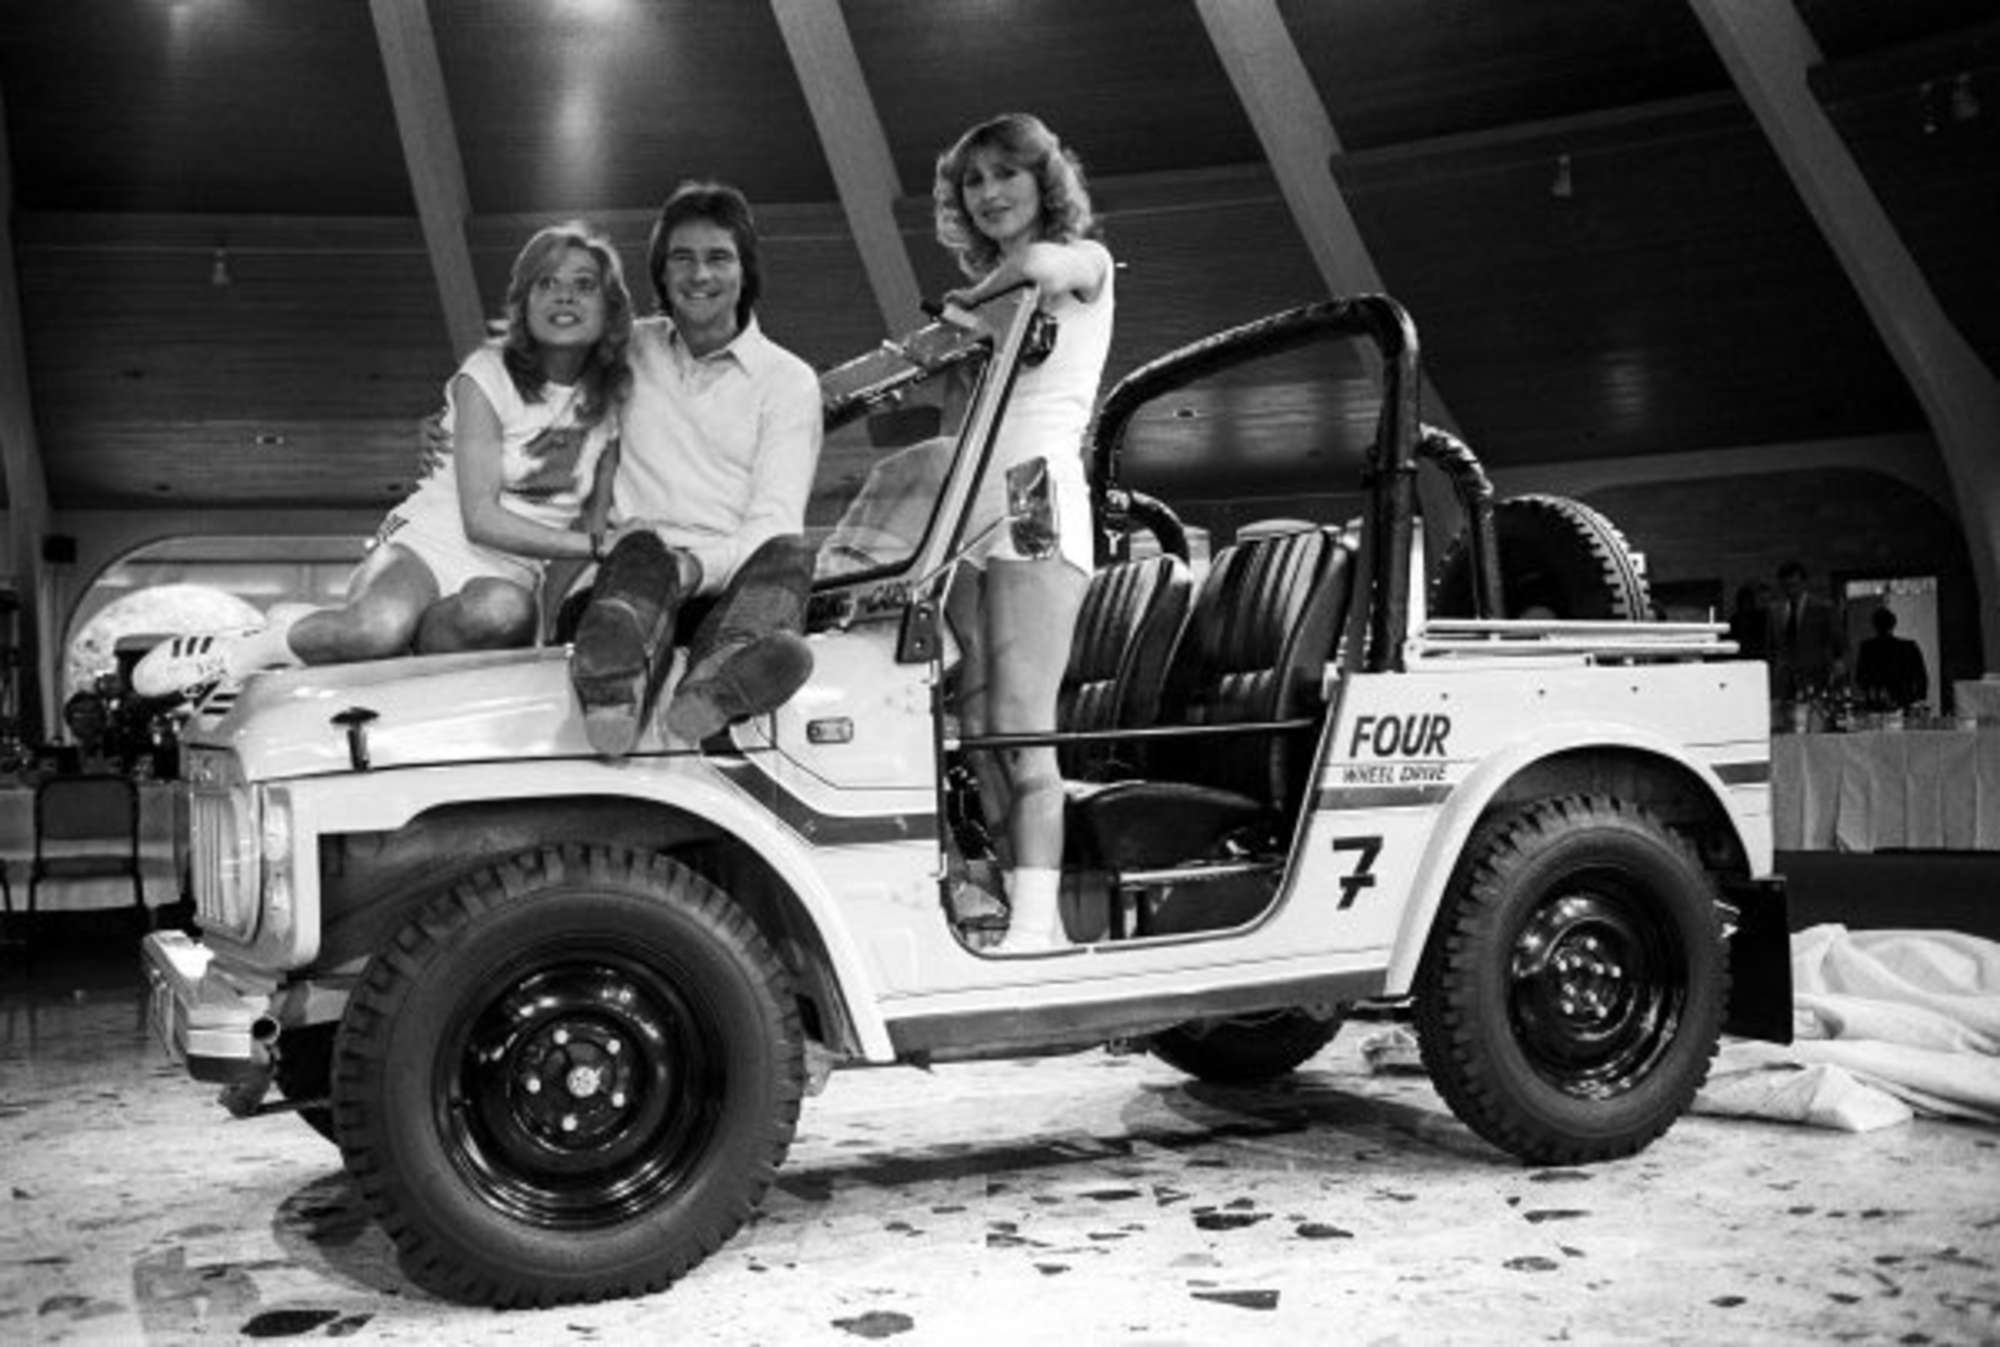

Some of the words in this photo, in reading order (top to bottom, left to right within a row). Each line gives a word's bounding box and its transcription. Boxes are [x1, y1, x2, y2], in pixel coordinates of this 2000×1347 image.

[1349, 714, 1451, 758] FOUR
[1343, 765, 1394, 784] WHEEL
[1399, 764, 1446, 782] DRIVE
[1332, 835, 1383, 910] 7
